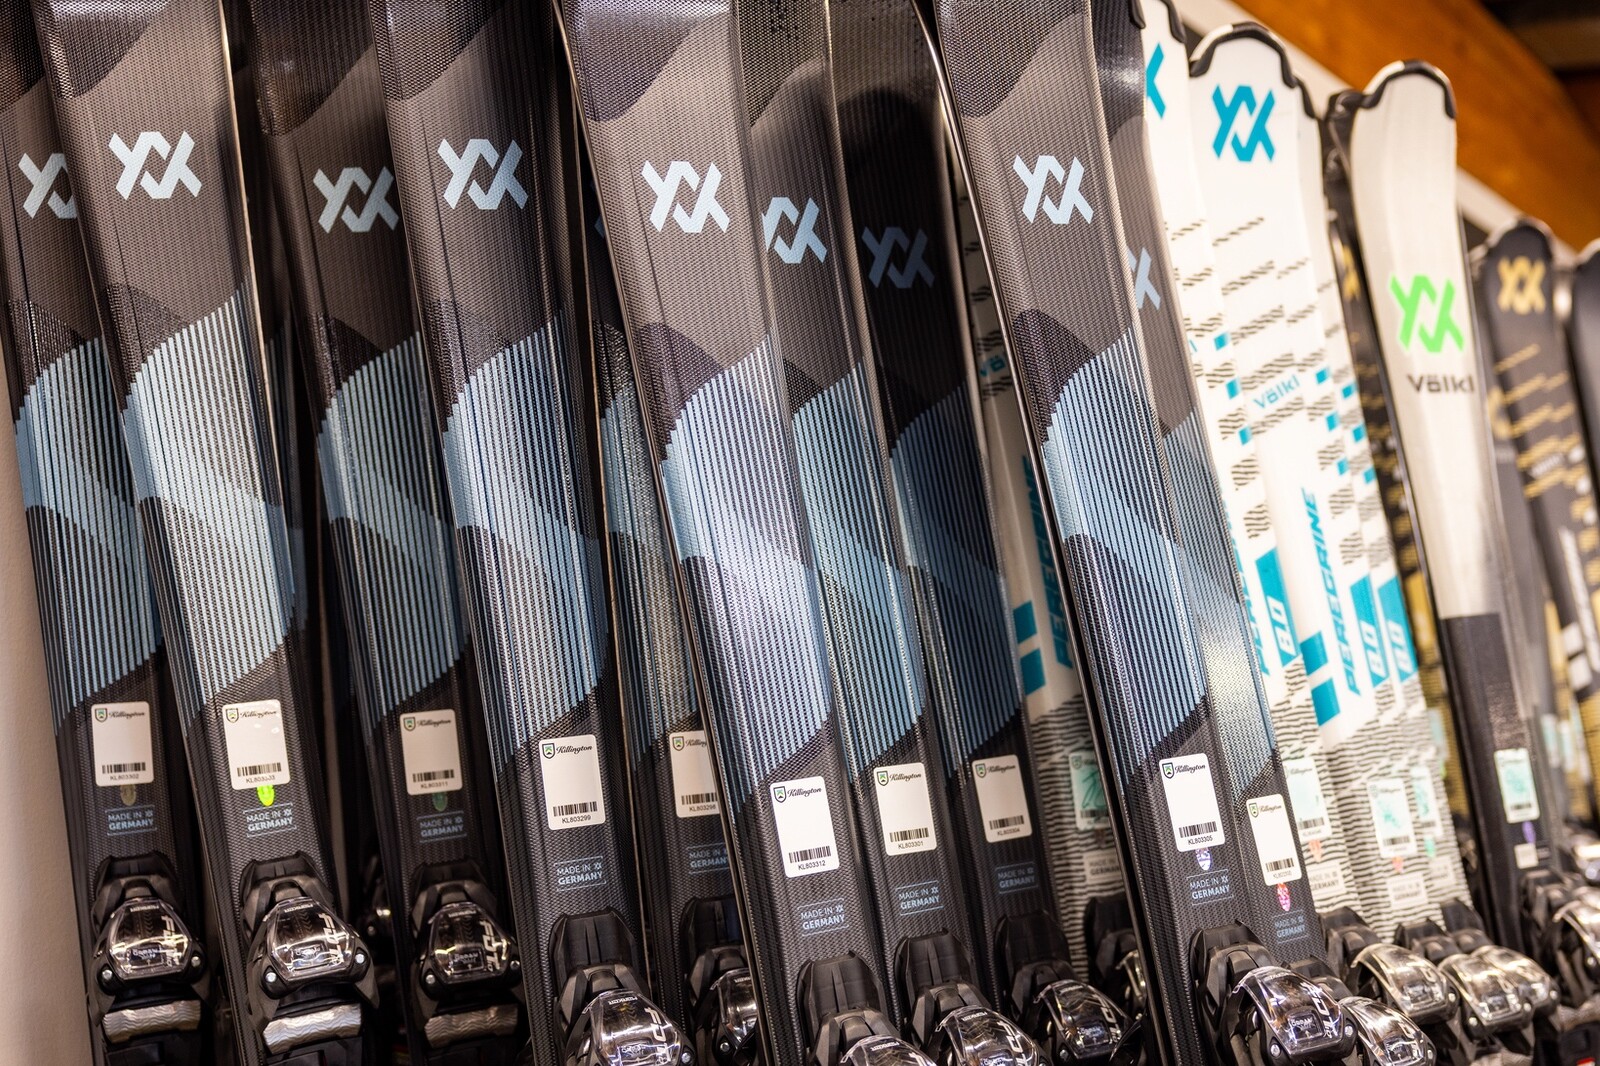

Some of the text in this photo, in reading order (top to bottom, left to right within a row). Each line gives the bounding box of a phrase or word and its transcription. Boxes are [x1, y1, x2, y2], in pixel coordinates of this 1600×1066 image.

[1407, 374, 1475, 393] Völkl
[1254, 374, 1299, 410] Völkl
[1302, 487, 1361, 696] PEREGRINE
[108, 710, 145, 719] Killington
[239, 710, 277, 719] Killington
[556, 745, 592, 755] Killington
[1175, 763, 1206, 775] Killington
[889, 772, 922, 783] Killington
[787, 787, 822, 798] Killington
[108, 811, 131, 821] MADE
[246, 812, 270, 823] MADE
[561, 815, 591, 824] KL803299
[108, 819, 154, 831] GERMANY
[248, 817, 293, 832] GERMANY
[419, 819, 442, 829] MADE
[420, 825, 463, 838] GERMANY
[557, 865, 581, 876] MADE
[798, 860, 826, 870] KL803312
[558, 872, 603, 885] GERMANY
[999, 876, 1035, 888] GERMANY
[1189, 879, 1212, 889] MADE
[899, 889, 919, 900] MADE
[1191, 885, 1230, 900] GERMANY
[901, 895, 940, 910] GERMANY
[800, 908, 823, 919] MADE
[802, 914, 845, 930] GERMANY
